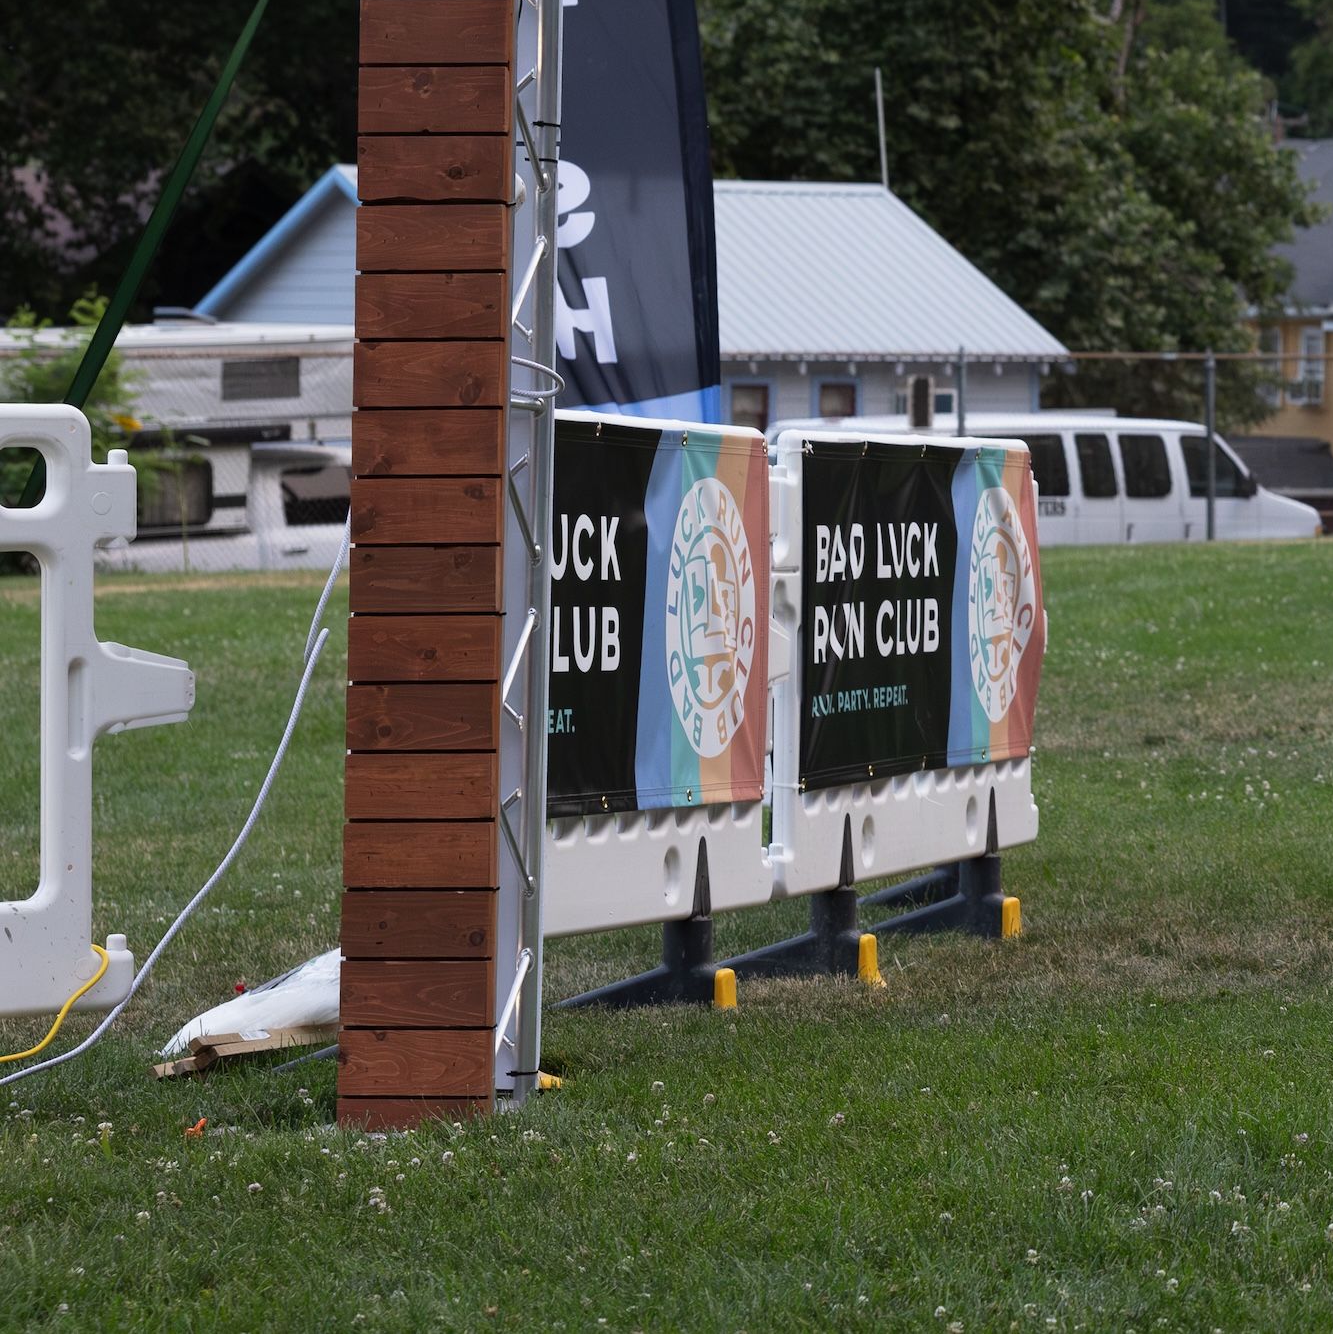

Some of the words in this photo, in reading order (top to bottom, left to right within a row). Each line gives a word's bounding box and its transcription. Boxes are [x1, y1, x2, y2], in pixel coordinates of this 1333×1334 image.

[551, 514, 621, 581] UCK
[667, 487, 706, 616] LUCK
[717, 490, 751, 586] RUN
[816, 523, 865, 583] BAD
[876, 522, 940, 579] LUCK
[552, 606, 621, 673] LUB
[813, 601, 865, 664] RUN
[876, 598, 940, 657] CLUB
[670, 650, 703, 748] BAD
[717, 616, 753, 746] CLUB
[837, 689, 871, 713] PARTY.
[873, 685, 908, 708] REPEAT.
[547, 708, 576, 734] EAT.
